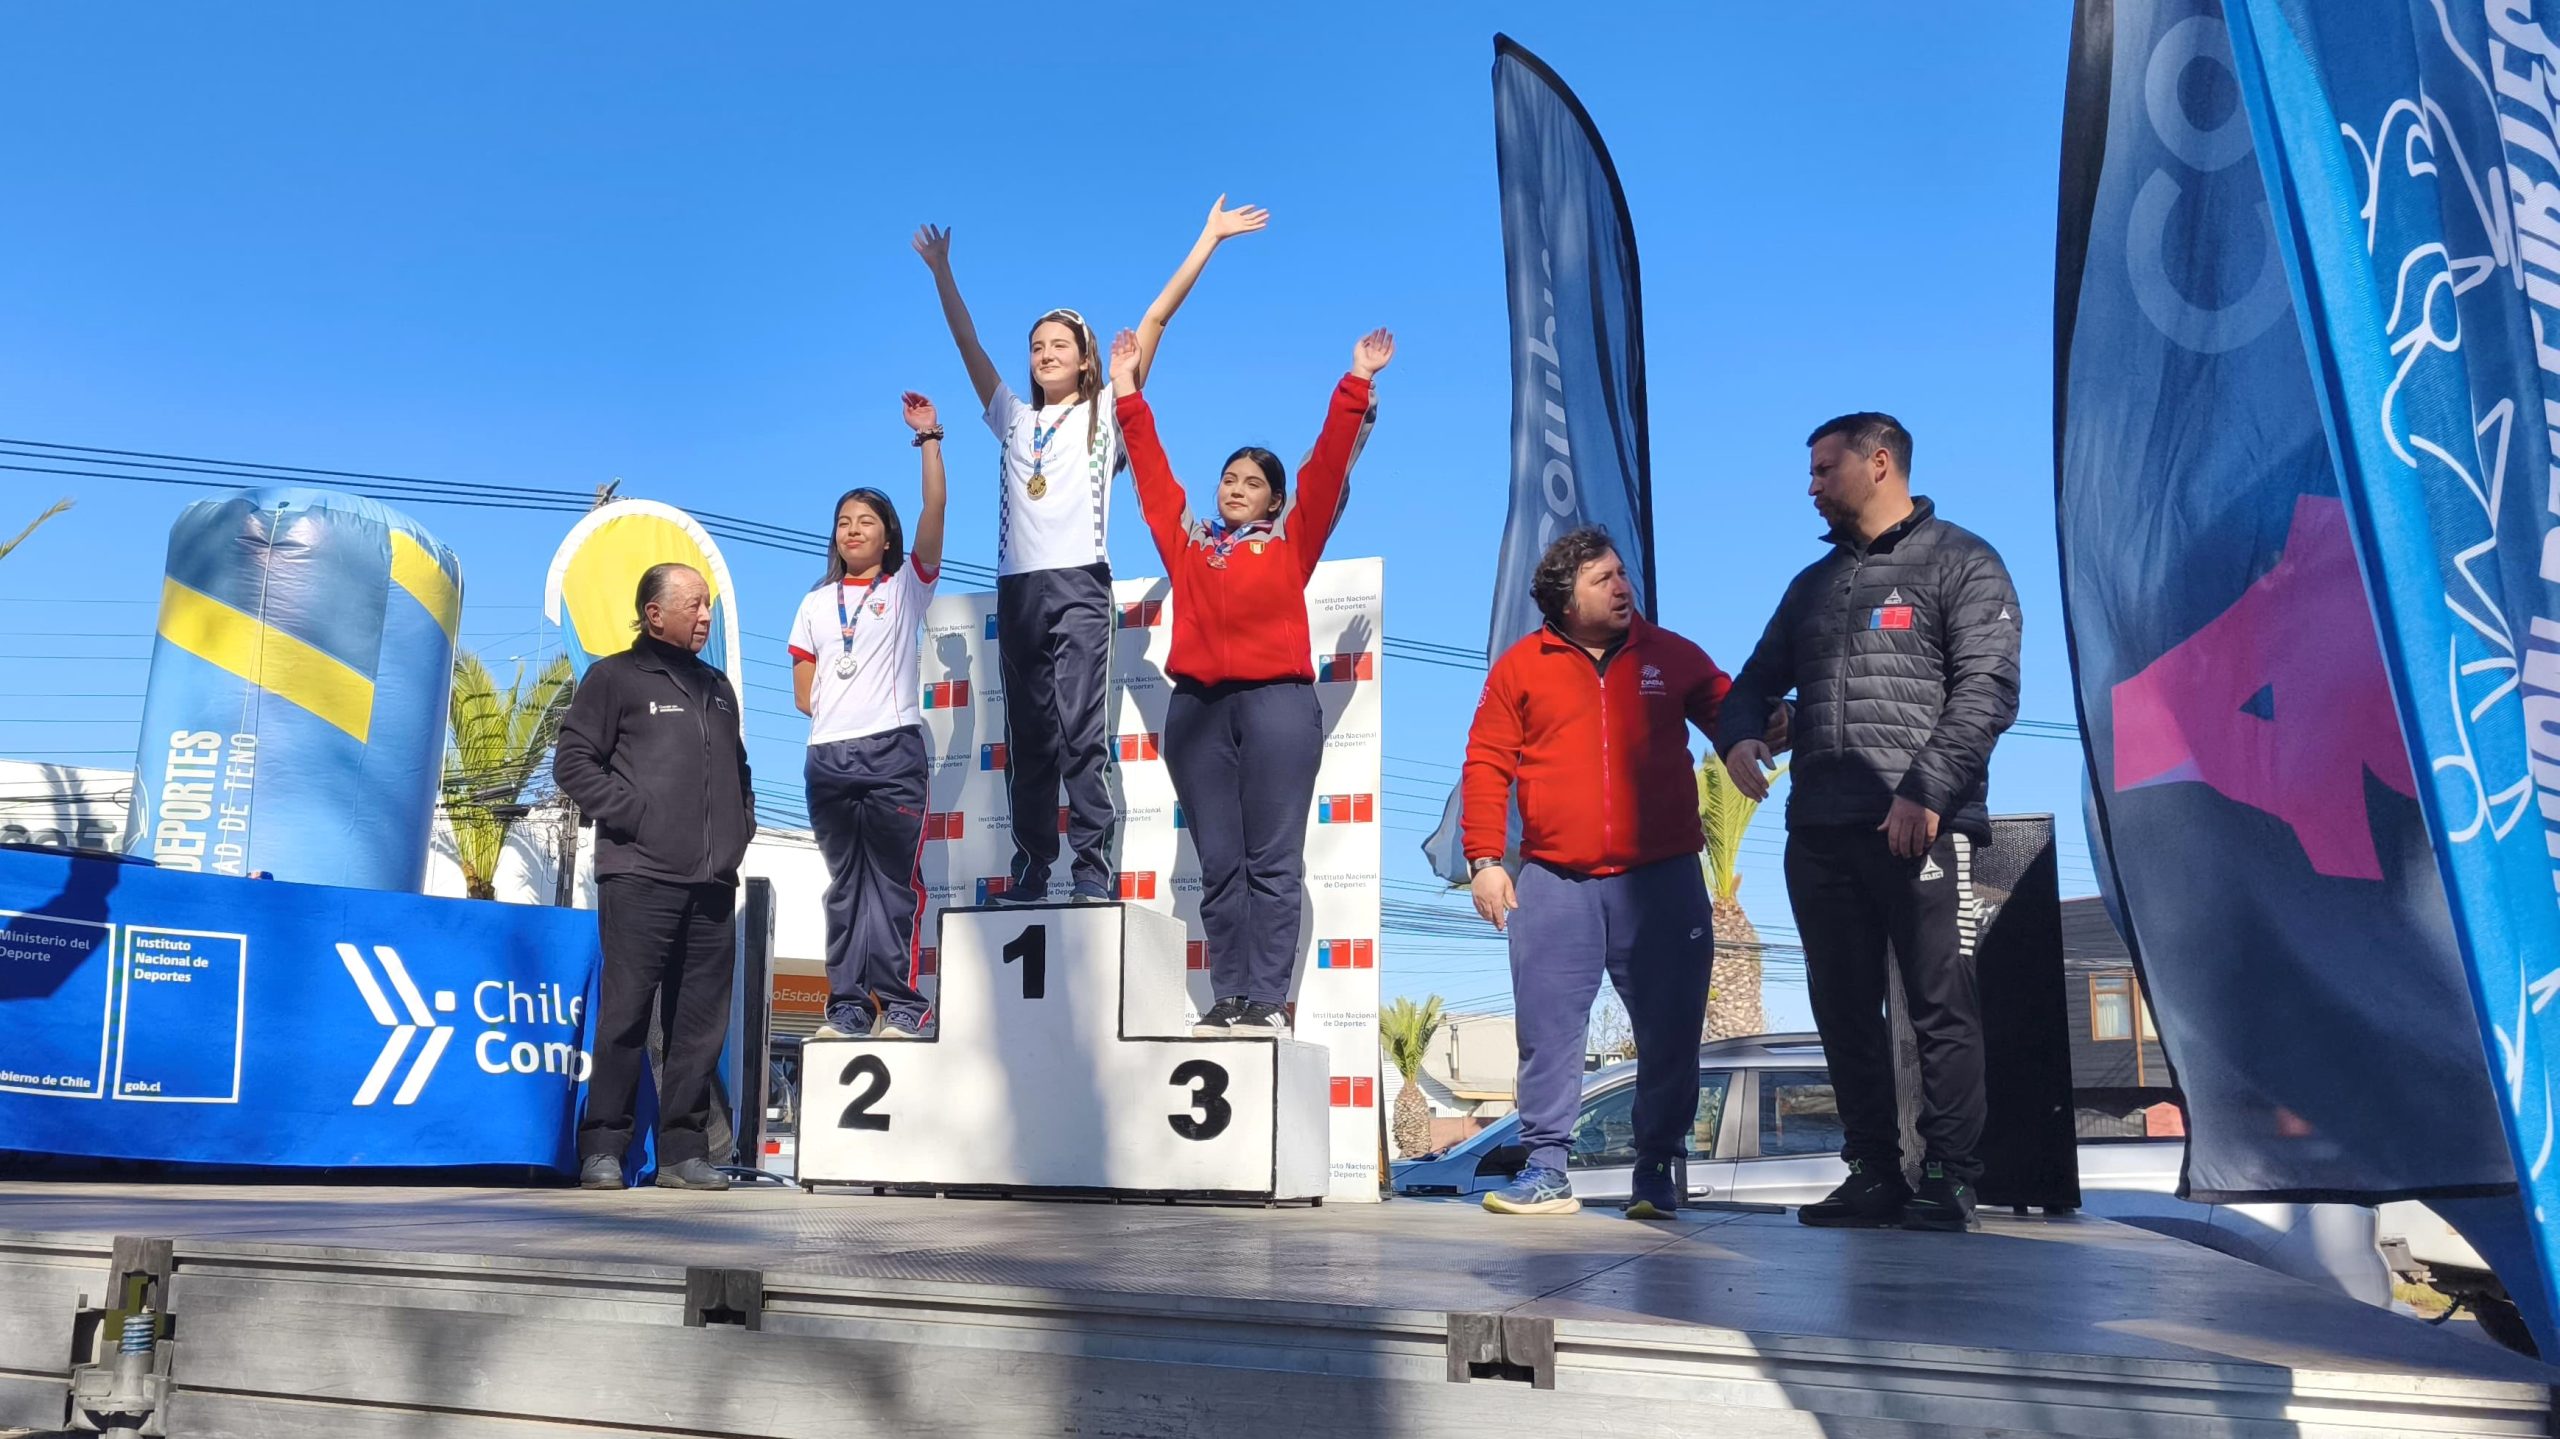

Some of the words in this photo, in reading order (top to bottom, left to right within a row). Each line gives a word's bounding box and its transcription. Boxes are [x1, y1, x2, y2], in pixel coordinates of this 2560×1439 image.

[1314, 597, 1345, 605] Instituto
[1346, 594, 1377, 603] Nacional
[1335, 603, 1367, 612] Deportes
[950, 623, 976, 632] Nacional
[1346, 732, 1377, 740] Nacional
[1334, 740, 1367, 748] Deportes
[945, 753, 971, 761] Nacional
[223, 733, 257, 791] TENO
[936, 760, 963, 769] Deportes
[1132, 807, 1162, 815] Nacional
[217, 803, 250, 832] DE
[1121, 815, 1152, 823] Deportes
[1169, 877, 1197, 885] Instituto
[1313, 873, 1345, 881] Instituto
[939, 884, 966, 892] Nacional
[1334, 881, 1367, 889] Deportes
[929, 892, 957, 900] Deportes
[0, 929, 67, 947] Ministerio
[70, 937, 90, 950] del
[136, 936, 192, 951] Instituto
[134, 952, 191, 968] Nacional
[192, 954, 209, 968] de
[1003, 924, 1046, 999] 1
[134, 968, 192, 983] Deportes
[473, 980, 584, 1027] Chile
[1334, 1020, 1367, 1028] Deportes
[42, 1073, 57, 1086] de
[59, 1076, 91, 1088] Chile
[124, 1081, 161, 1093] gob.cl
[838, 1054, 891, 1131] 2
[1168, 1059, 1232, 1141] 3
[1345, 1162, 1377, 1171] Nacional
[1334, 1170, 1367, 1179] Deportes
